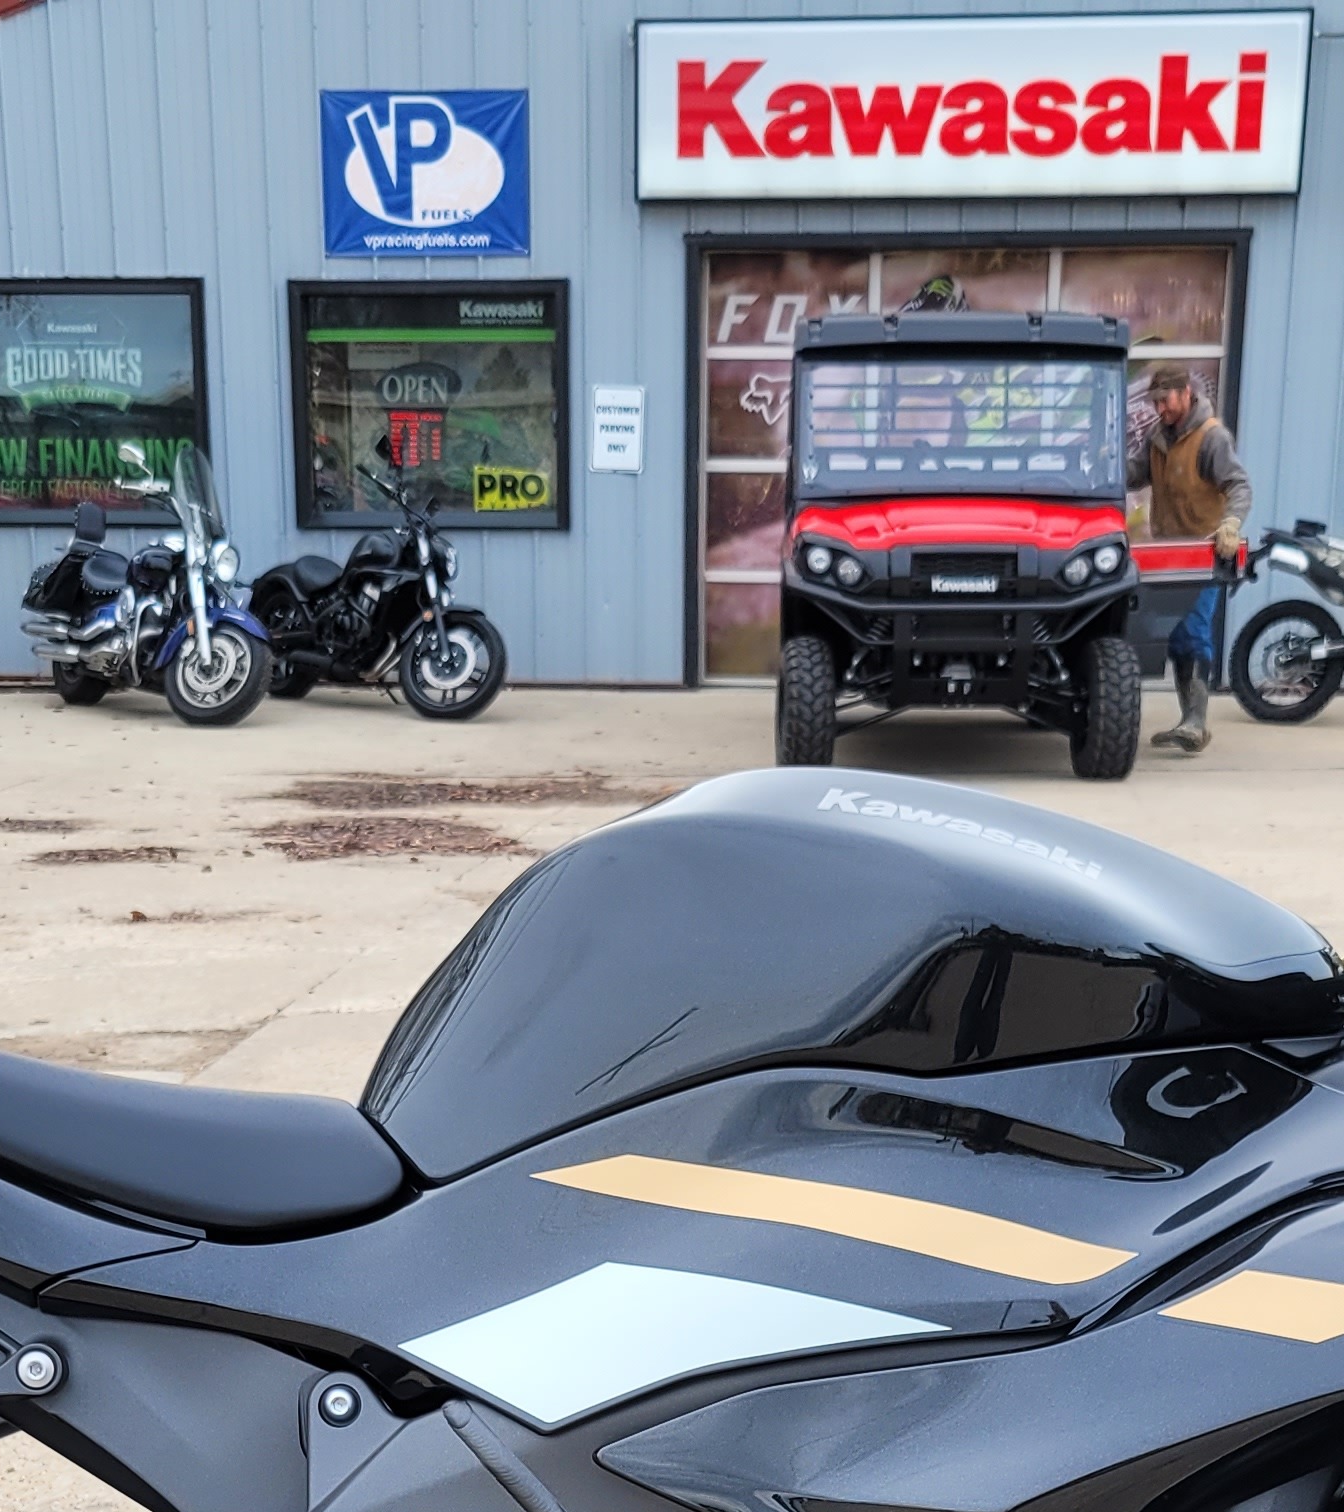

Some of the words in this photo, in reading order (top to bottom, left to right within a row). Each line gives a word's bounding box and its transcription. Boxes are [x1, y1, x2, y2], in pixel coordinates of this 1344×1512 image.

[676, 51, 1269, 159] Kawasaki
[348, 98, 453, 222] VP
[421, 209, 474, 221] FUELS
[362, 232, 490, 251] vpracingfuels.com
[459, 300, 544, 318] Kawasaki
[47, 322, 97, 335] Kawasaki
[7, 348, 70, 389] GOOD
[76, 348, 143, 389] TIMES
[382, 374, 448, 404] OPEN
[596, 405, 640, 416] CUSTOMER
[599, 424, 635, 434] PARKING
[607, 444, 626, 453] ONLY
[478, 474, 545, 502] PRO
[931, 574, 998, 594] Kawasaki
[816, 787, 1104, 881] Kawasaki
